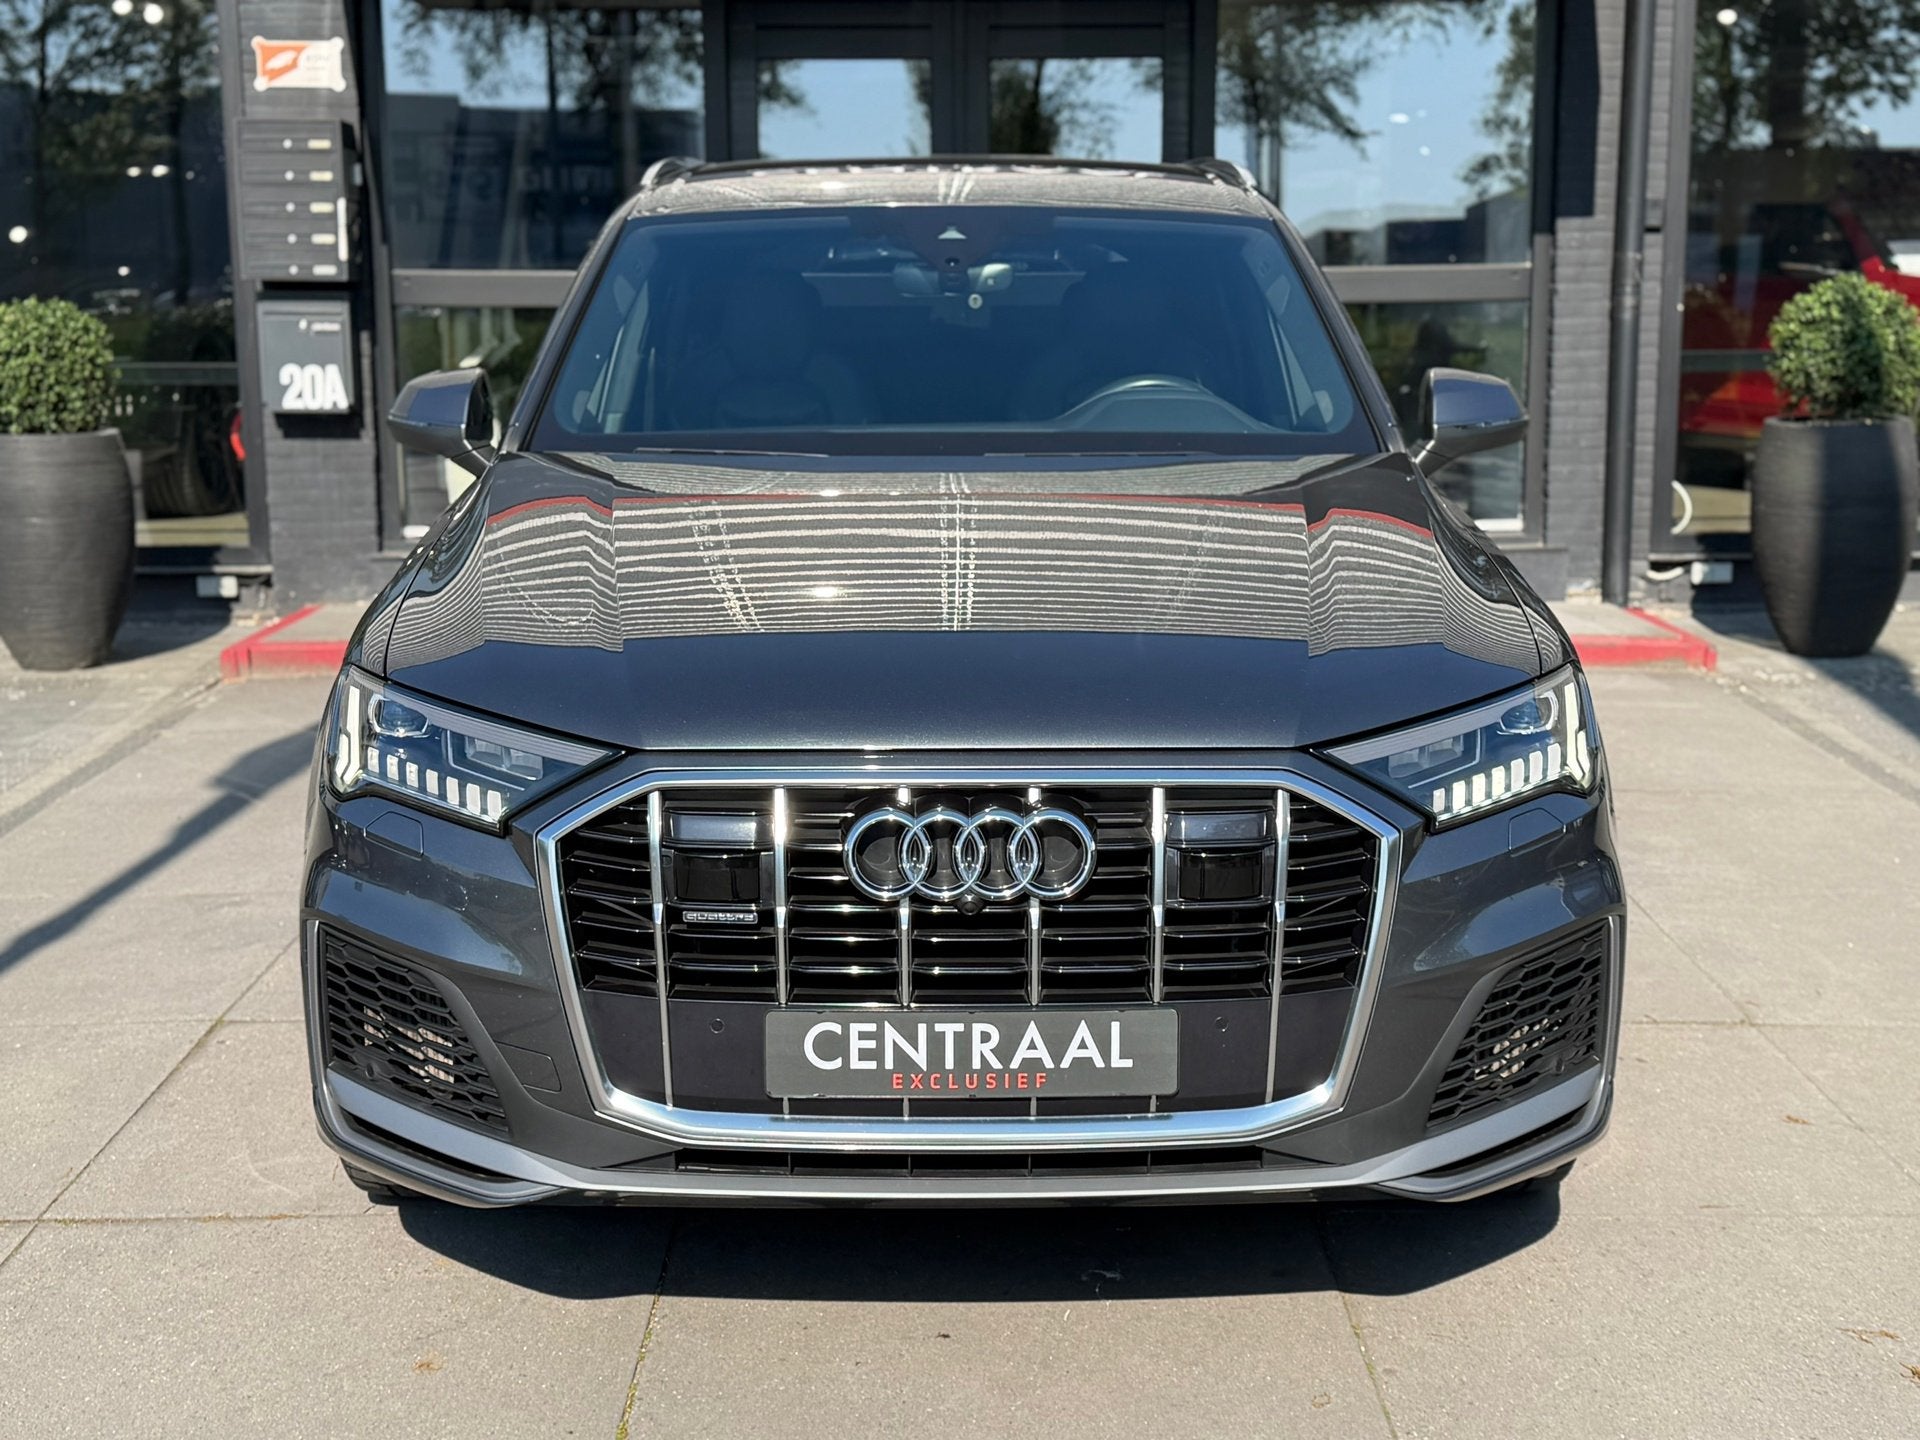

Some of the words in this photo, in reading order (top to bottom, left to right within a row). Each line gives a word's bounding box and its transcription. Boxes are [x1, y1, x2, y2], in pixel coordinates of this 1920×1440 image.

[279, 363, 349, 410] 20A
[803, 1019, 1134, 1072] CENTRAAL
[892, 1073, 1047, 1090] EXCLUSIEF
